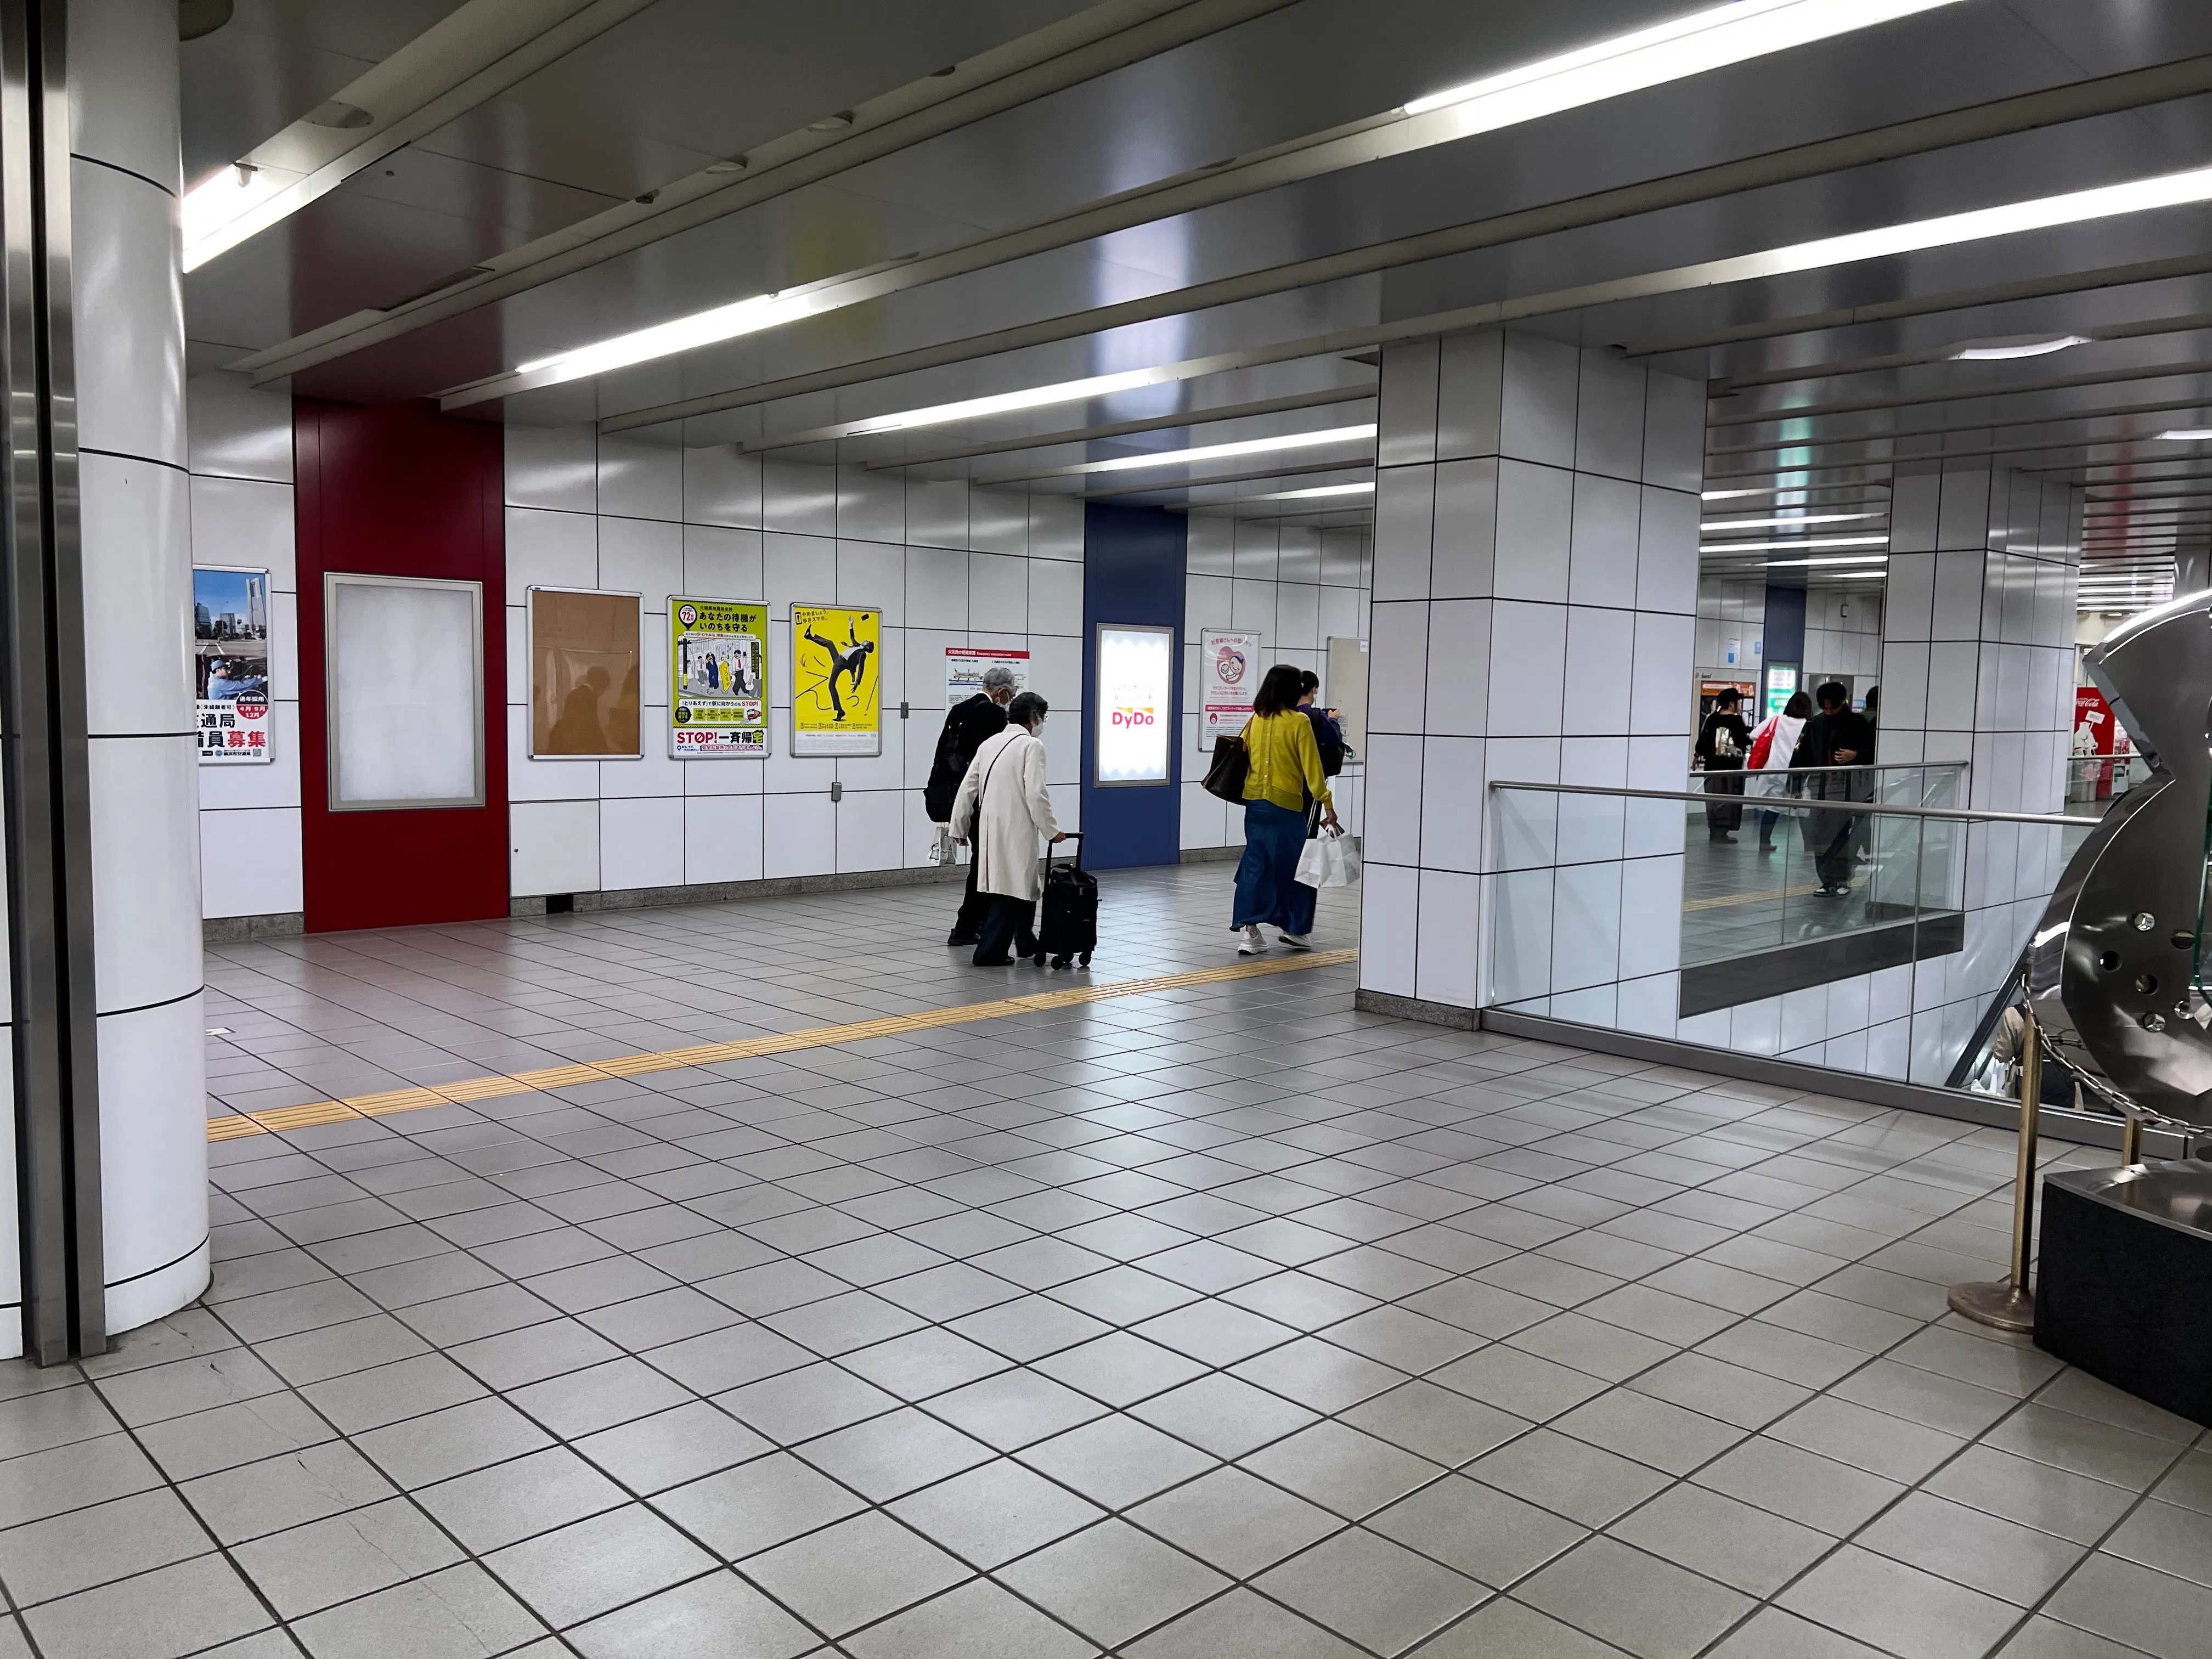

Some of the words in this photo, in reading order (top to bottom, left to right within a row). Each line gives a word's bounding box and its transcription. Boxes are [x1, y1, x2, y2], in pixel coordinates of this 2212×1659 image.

[699, 612, 757, 623] あなたの待機が
[699, 623, 748, 632] いのちを守る
[196, 713, 235, 728] 通局
[1112, 712, 1154, 729] DyDo
[677, 731, 717, 744] STOP!
[719, 730, 764, 744] 一斉帰宅
